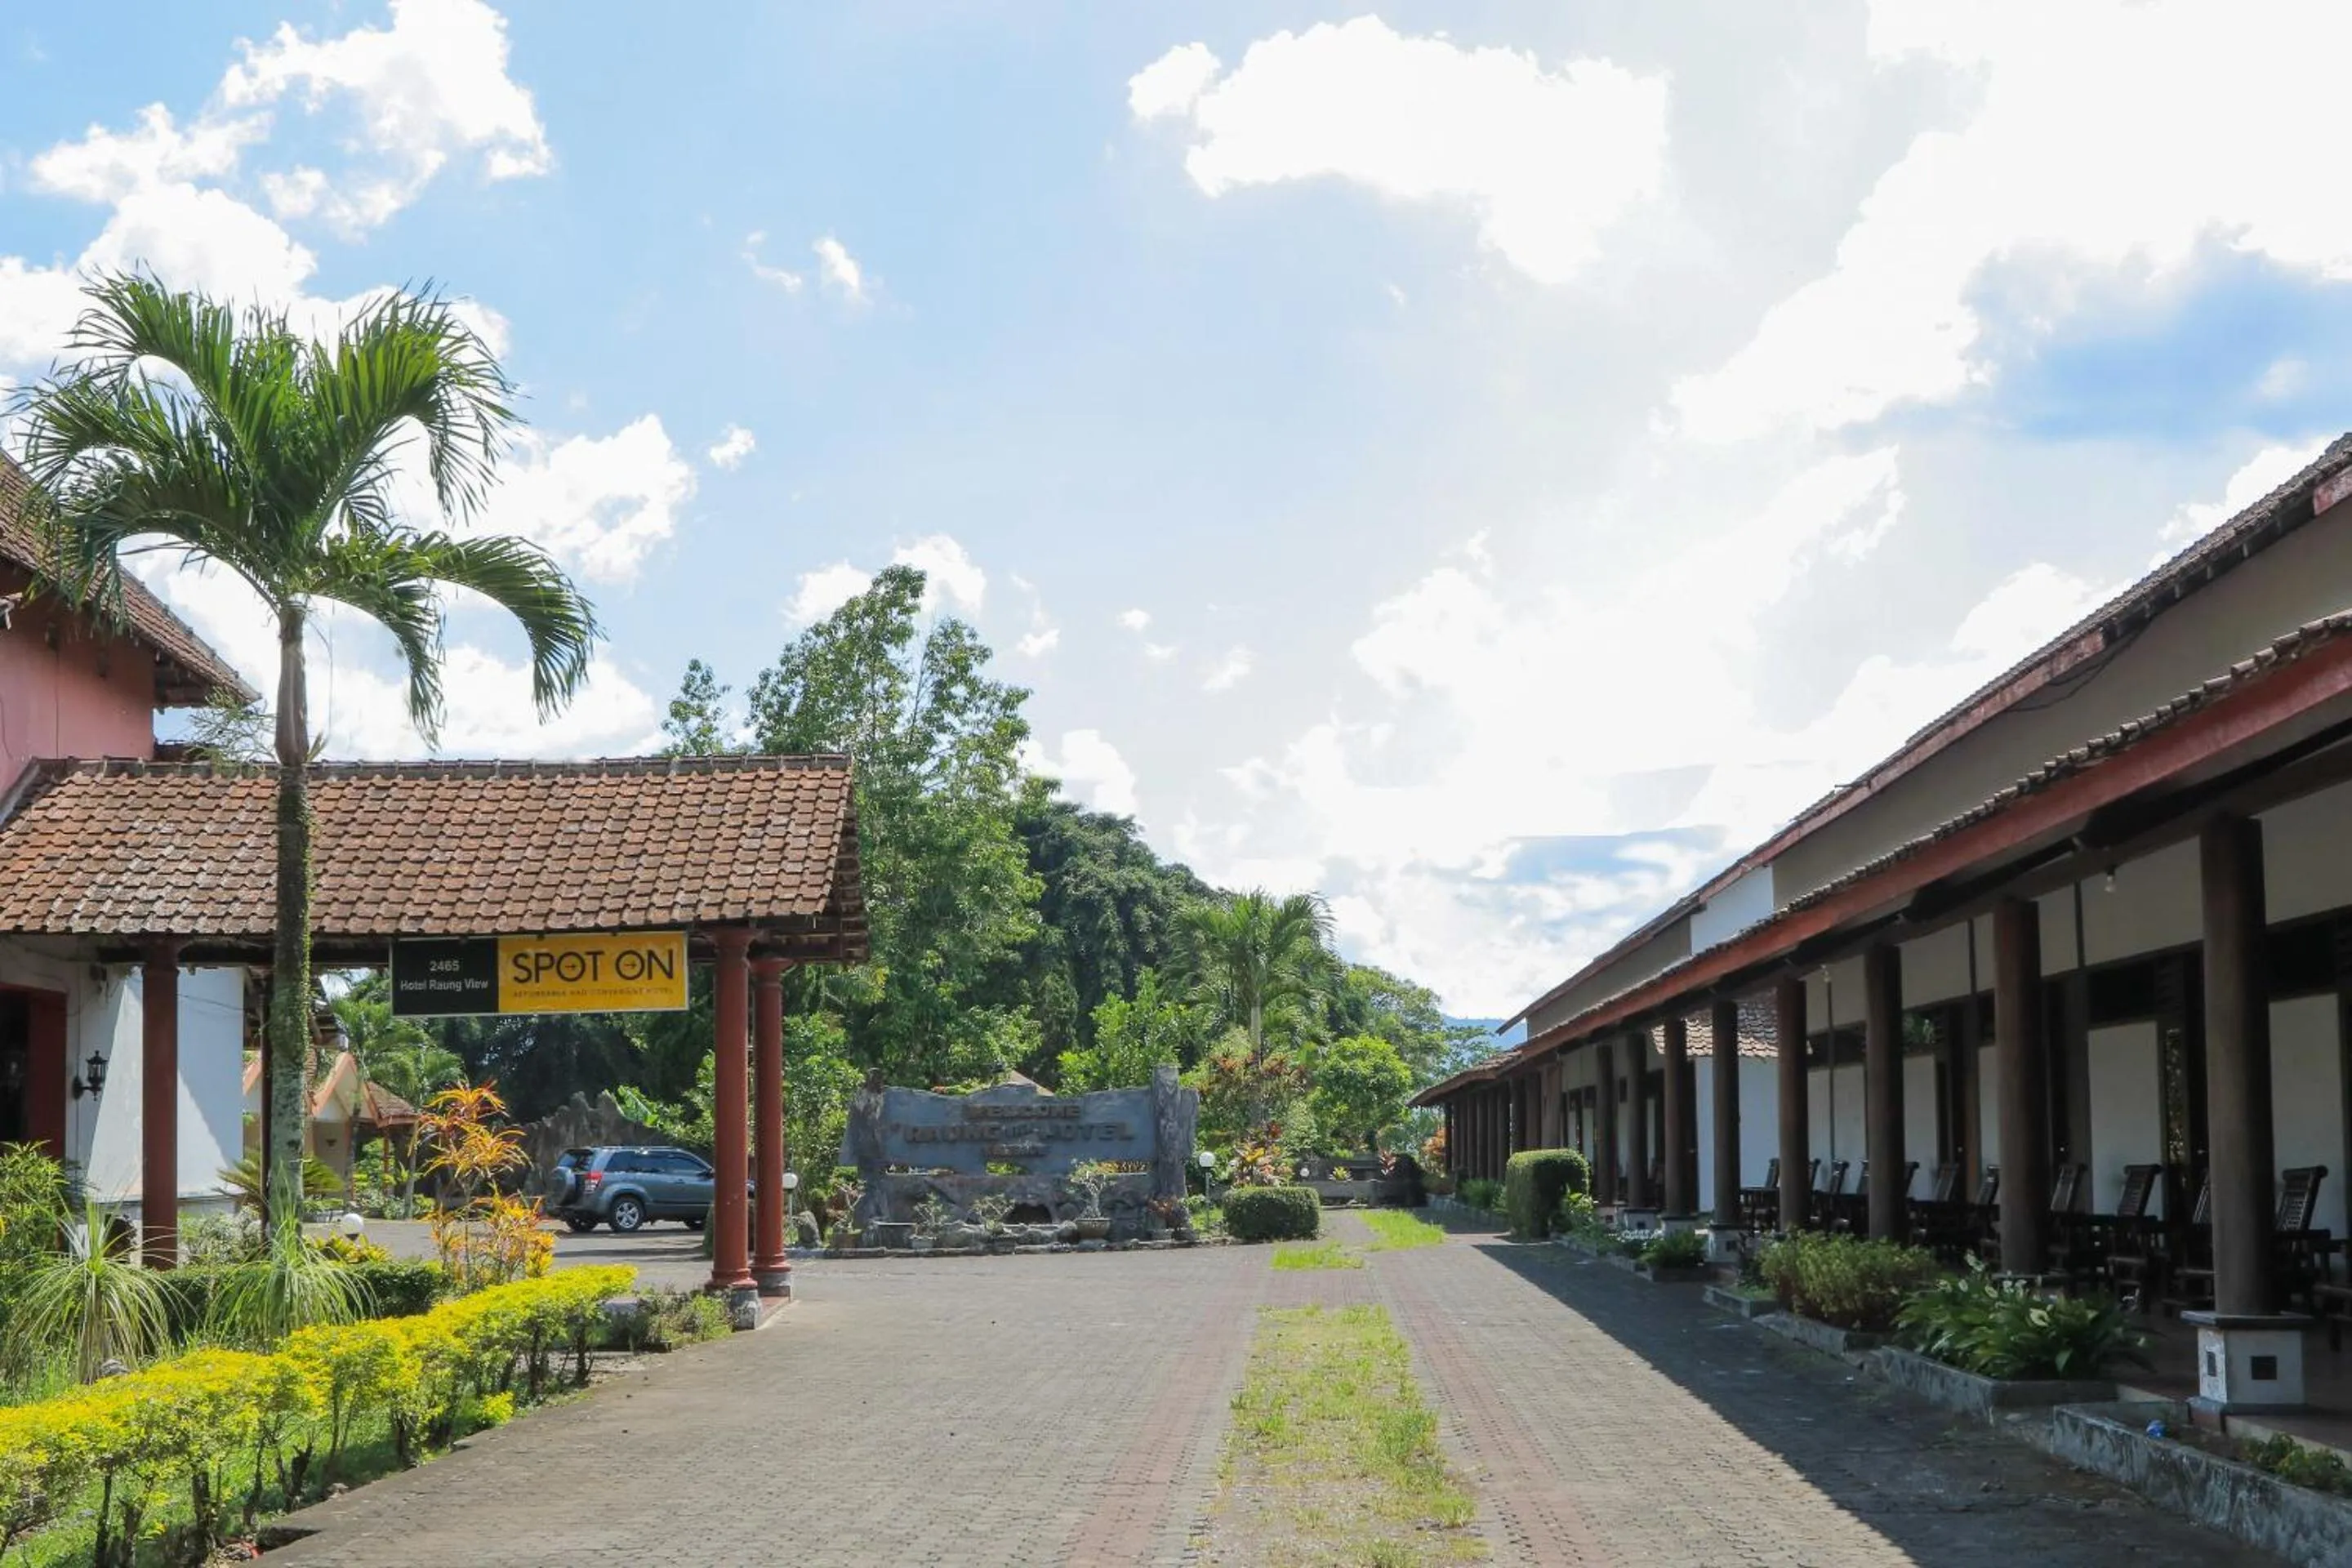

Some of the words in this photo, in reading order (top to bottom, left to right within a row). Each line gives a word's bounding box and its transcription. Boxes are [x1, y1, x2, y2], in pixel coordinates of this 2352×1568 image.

[430, 960, 460, 971] 2465
[513, 951, 604, 983] SPOT
[616, 949, 674, 980] ON
[400, 980, 426, 991] Hotel
[429, 979, 461, 991] Raung
[464, 978, 488, 990] View
